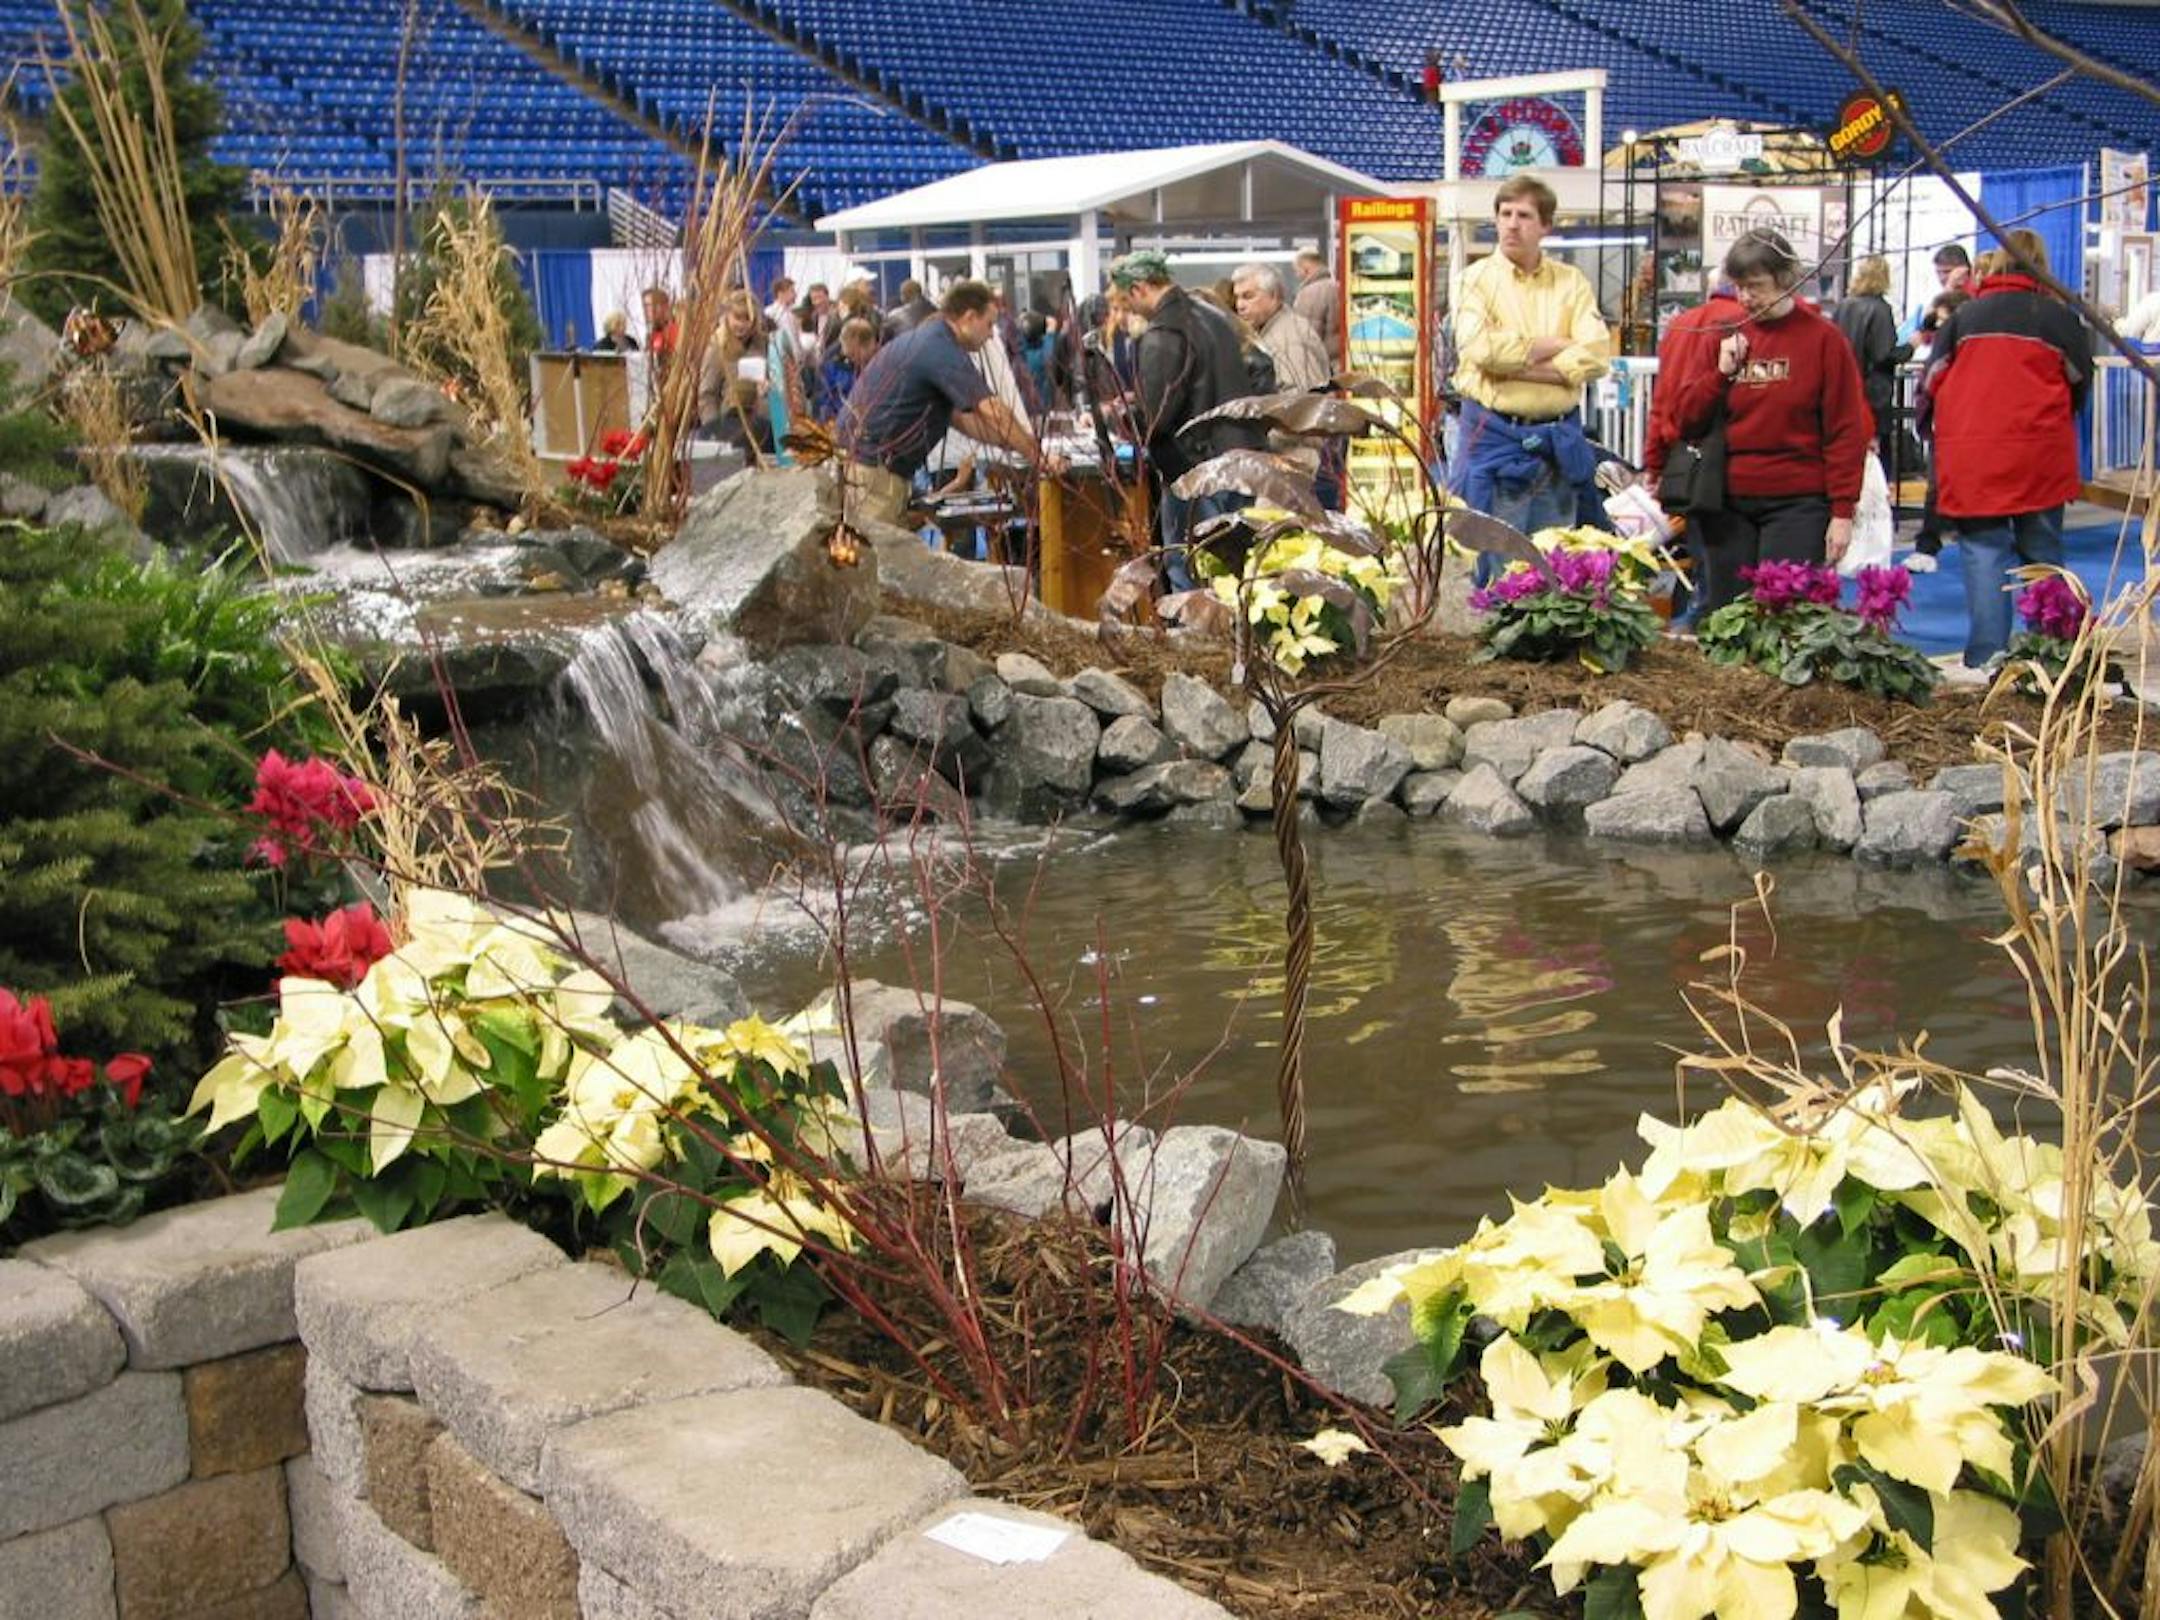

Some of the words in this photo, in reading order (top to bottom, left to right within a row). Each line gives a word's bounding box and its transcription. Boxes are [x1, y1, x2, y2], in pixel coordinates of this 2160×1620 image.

[1829, 93, 1899, 151] GORDYS
[1351, 201, 1415, 218] Railings
[1712, 214, 1810, 238] RAILCRAFT
